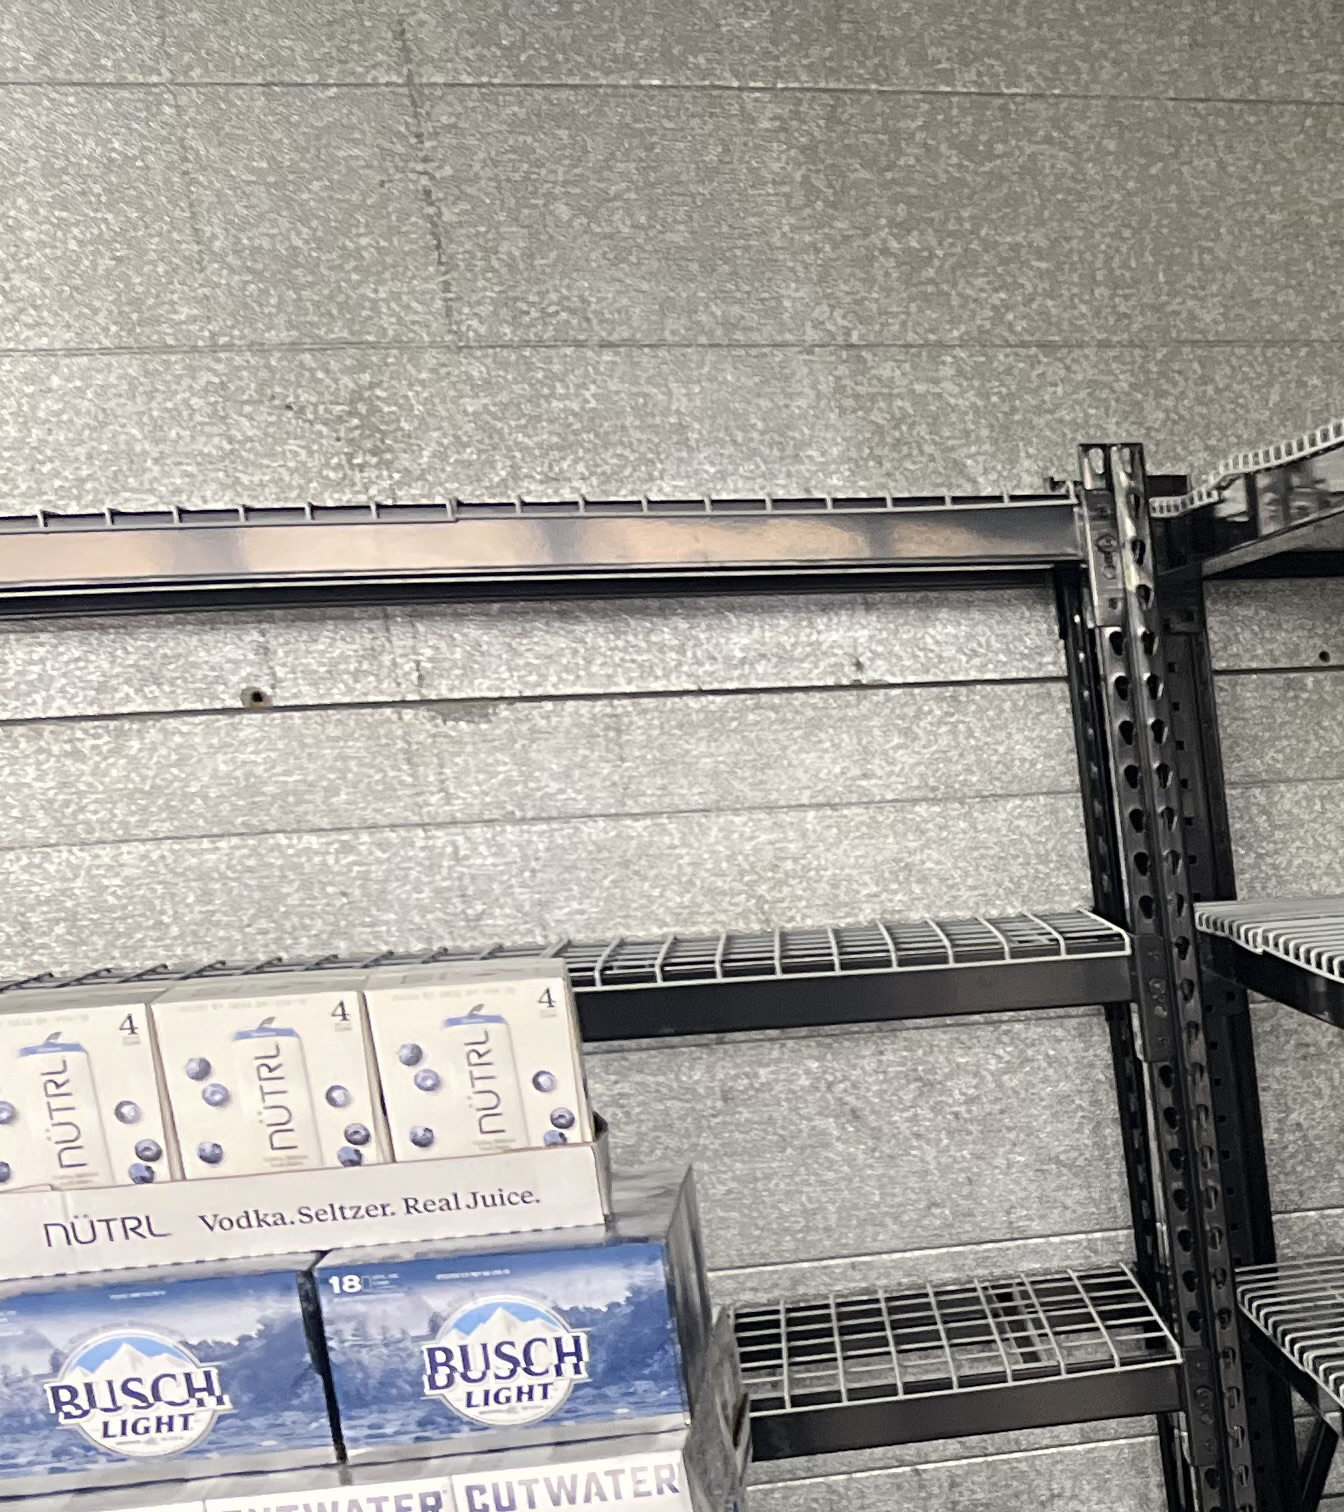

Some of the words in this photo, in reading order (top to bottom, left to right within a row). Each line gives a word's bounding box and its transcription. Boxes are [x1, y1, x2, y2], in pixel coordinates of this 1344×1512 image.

[536, 987, 557, 1008] 4
[331, 1000, 350, 1022] 4
[119, 1013, 139, 1036] 4
[198, 1206, 296, 1233] Vodka.
[299, 1197, 397, 1226] Seltzer.
[403, 1191, 462, 1217] Real
[464, 1184, 542, 1211] Juice.
[328, 1274, 363, 1294] 18
[425, 1334, 584, 1391] BUSCH
[50, 1369, 227, 1420] BUSCH
[465, 1383, 553, 1408] LIGHT
[101, 1413, 195, 1439] LIGHT
